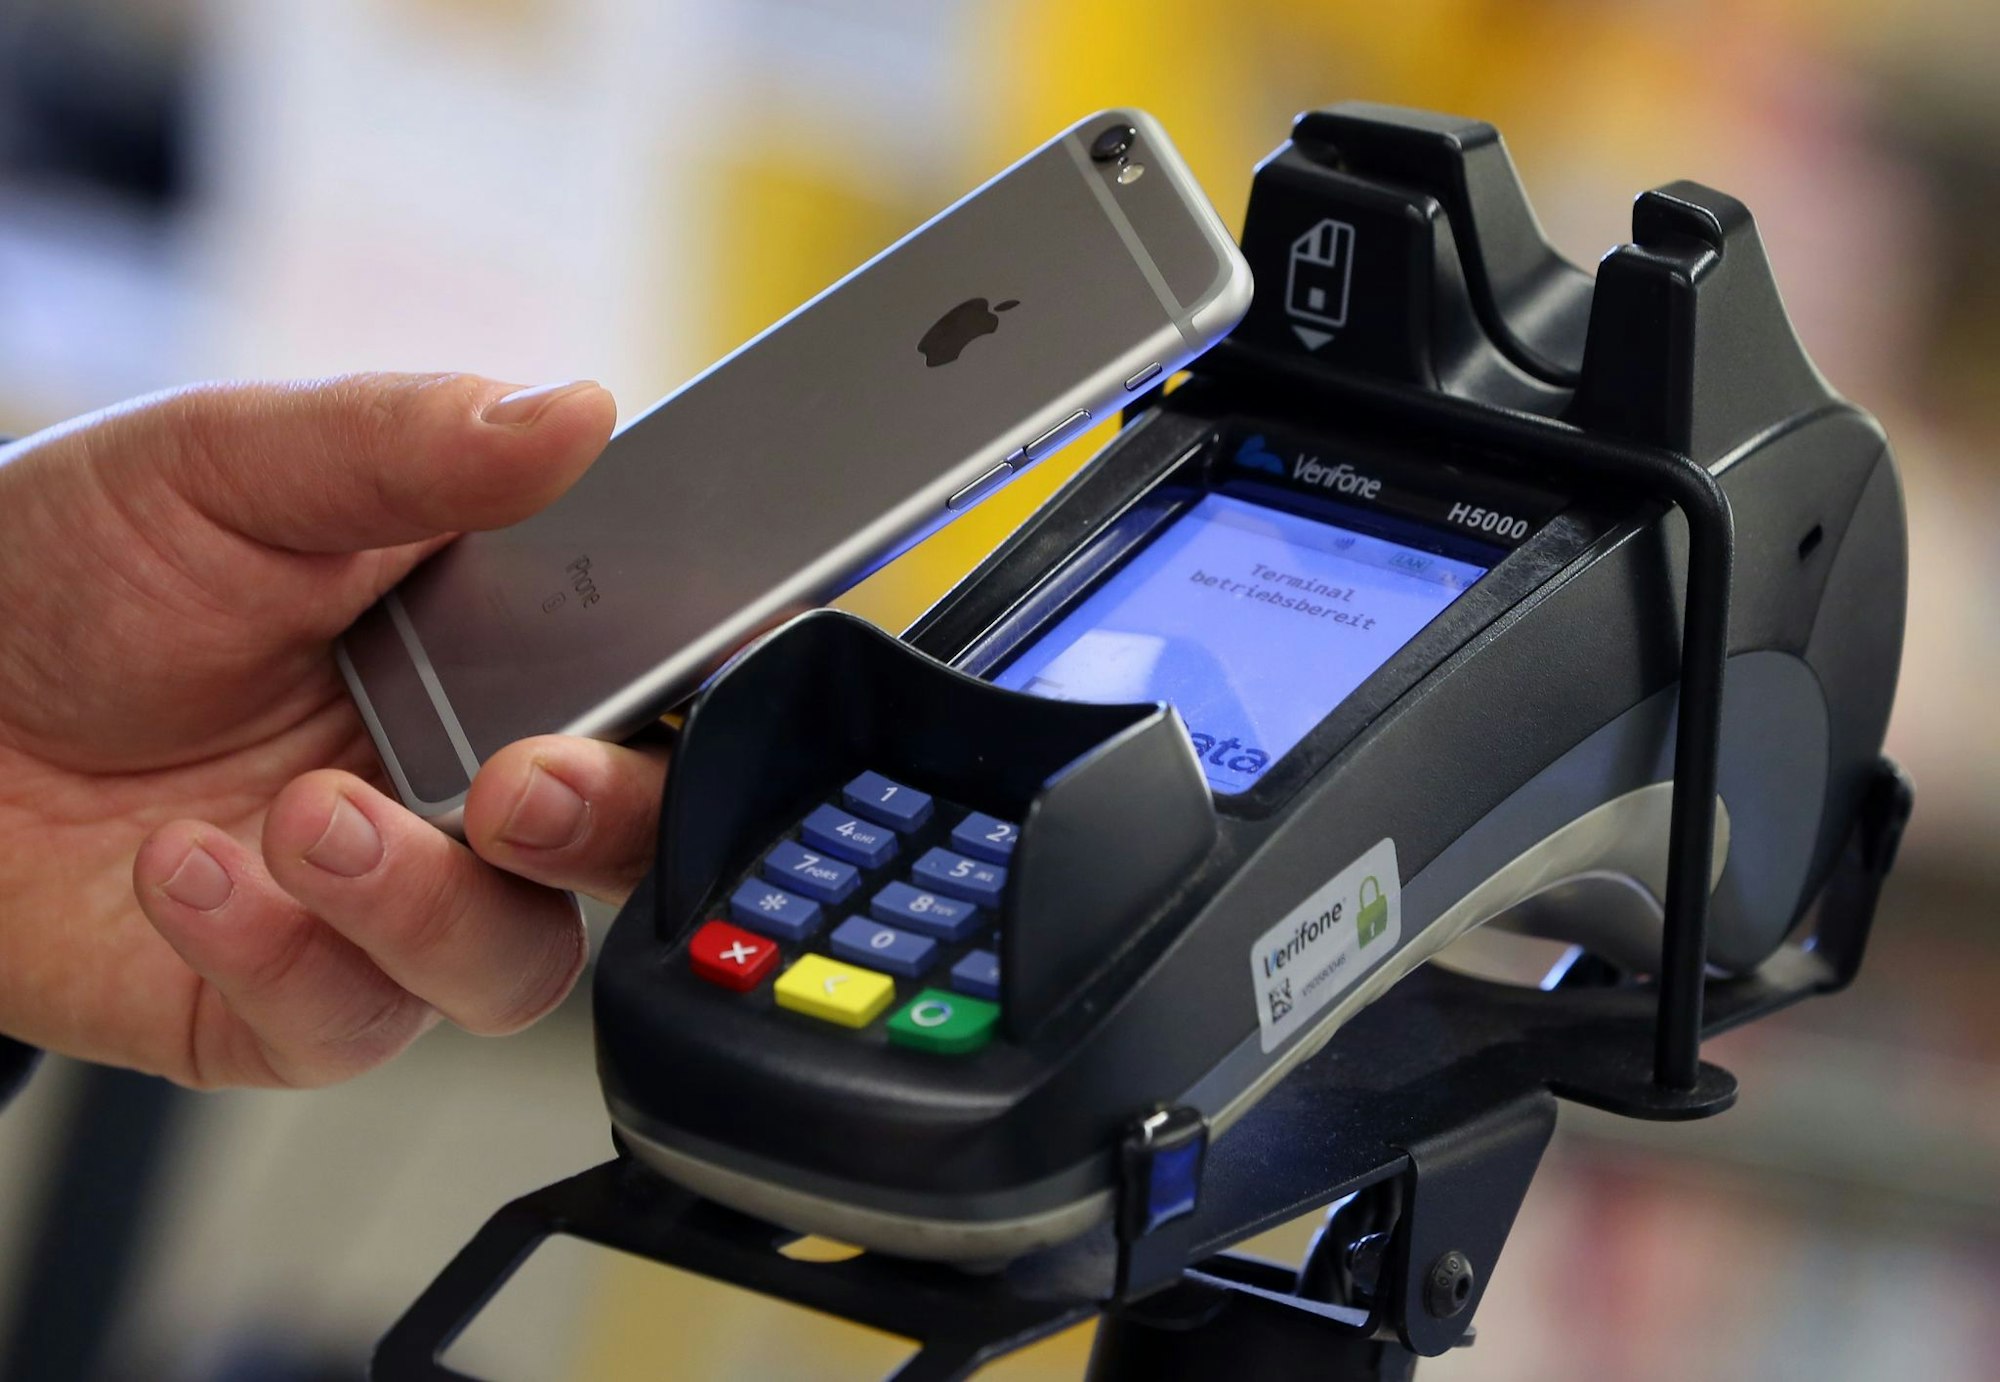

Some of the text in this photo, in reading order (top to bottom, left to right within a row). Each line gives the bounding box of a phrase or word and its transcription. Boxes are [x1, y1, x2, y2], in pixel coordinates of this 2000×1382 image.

[1447, 502, 1528, 540] H5000
[1251, 563, 1356, 602] Terminal
[1190, 570, 1376, 631] betriebsbereit
[1183, 719, 1271, 774] ata
[880, 787, 898, 802] 1
[835, 821, 857, 837] 4
[985, 825, 1010, 842] 2
[793, 854, 819, 870] 7
[949, 861, 974, 877] 5
[909, 896, 934, 911] 8
[1264, 902, 1342, 978] Verifone
